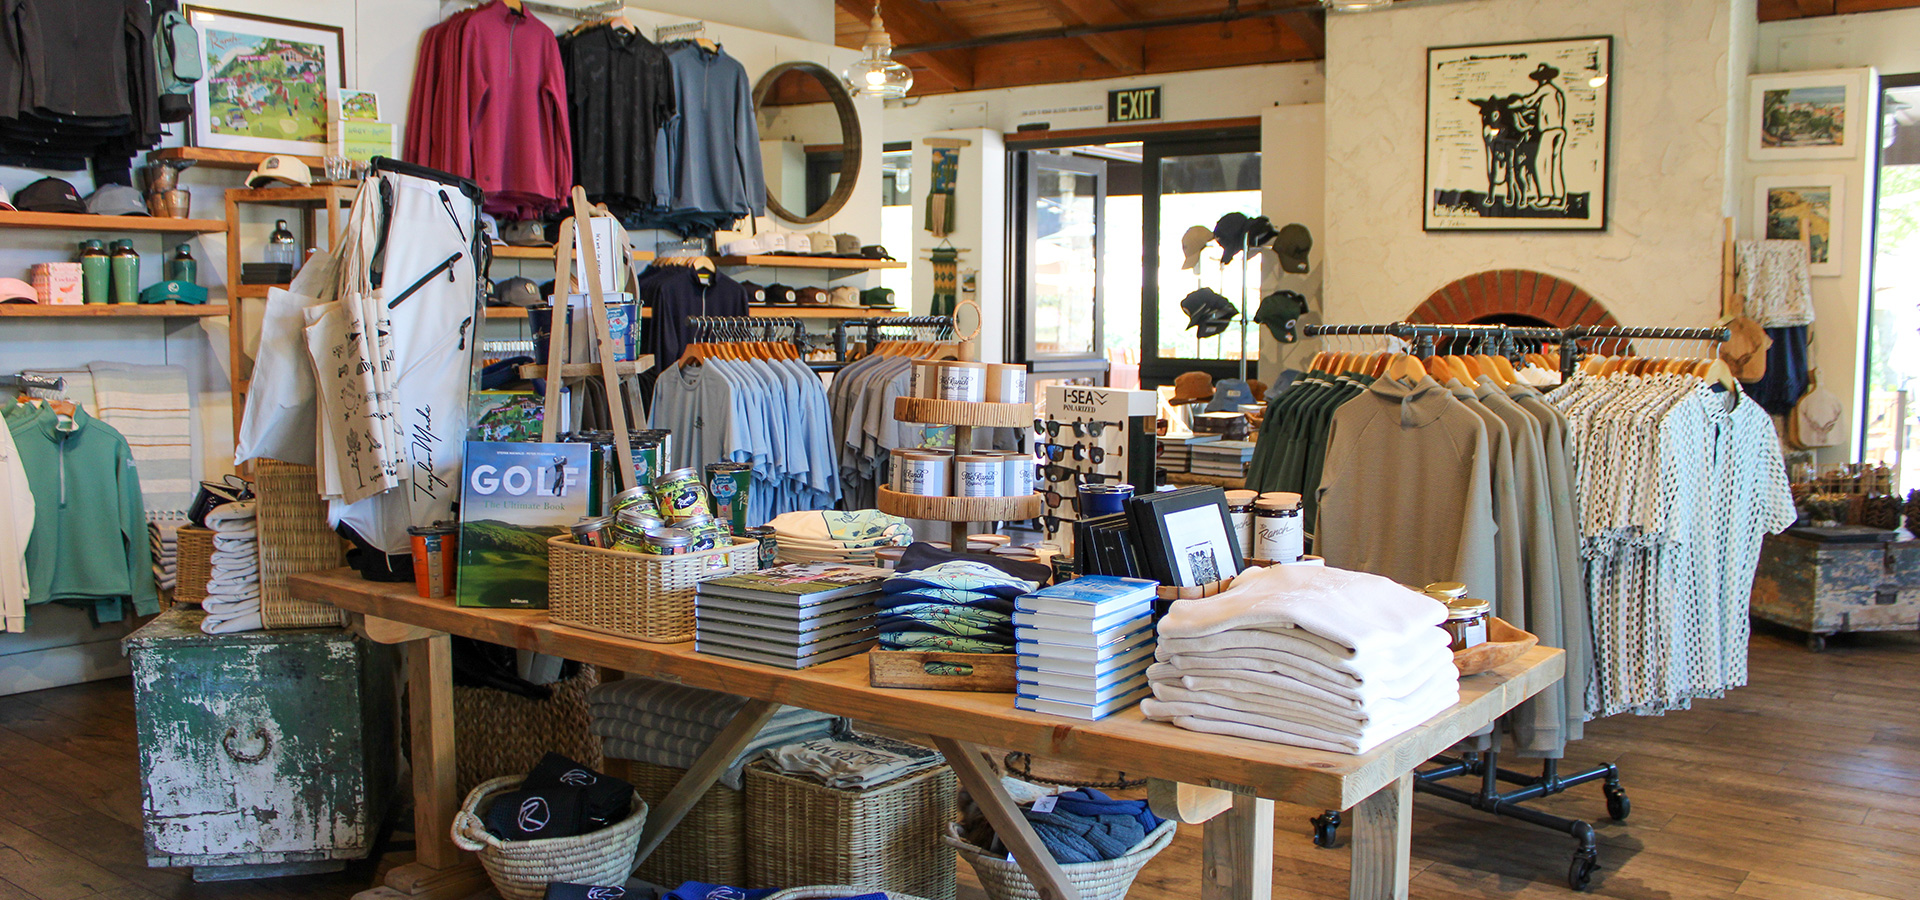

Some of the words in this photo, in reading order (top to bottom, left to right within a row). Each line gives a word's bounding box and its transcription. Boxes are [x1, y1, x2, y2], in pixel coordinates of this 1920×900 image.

[1117, 90, 1155, 121] EXIT
[1063, 389, 1094, 405] I-SEA
[1063, 404, 1096, 413] POLARIZED
[412, 403, 449, 502] TaylorMade
[470, 464, 580, 496] GOLF
[483, 500, 501, 509] The
[503, 501, 541, 511] Ultimate
[543, 502, 566, 511] Book
[1258, 521, 1294, 545] Ranch
